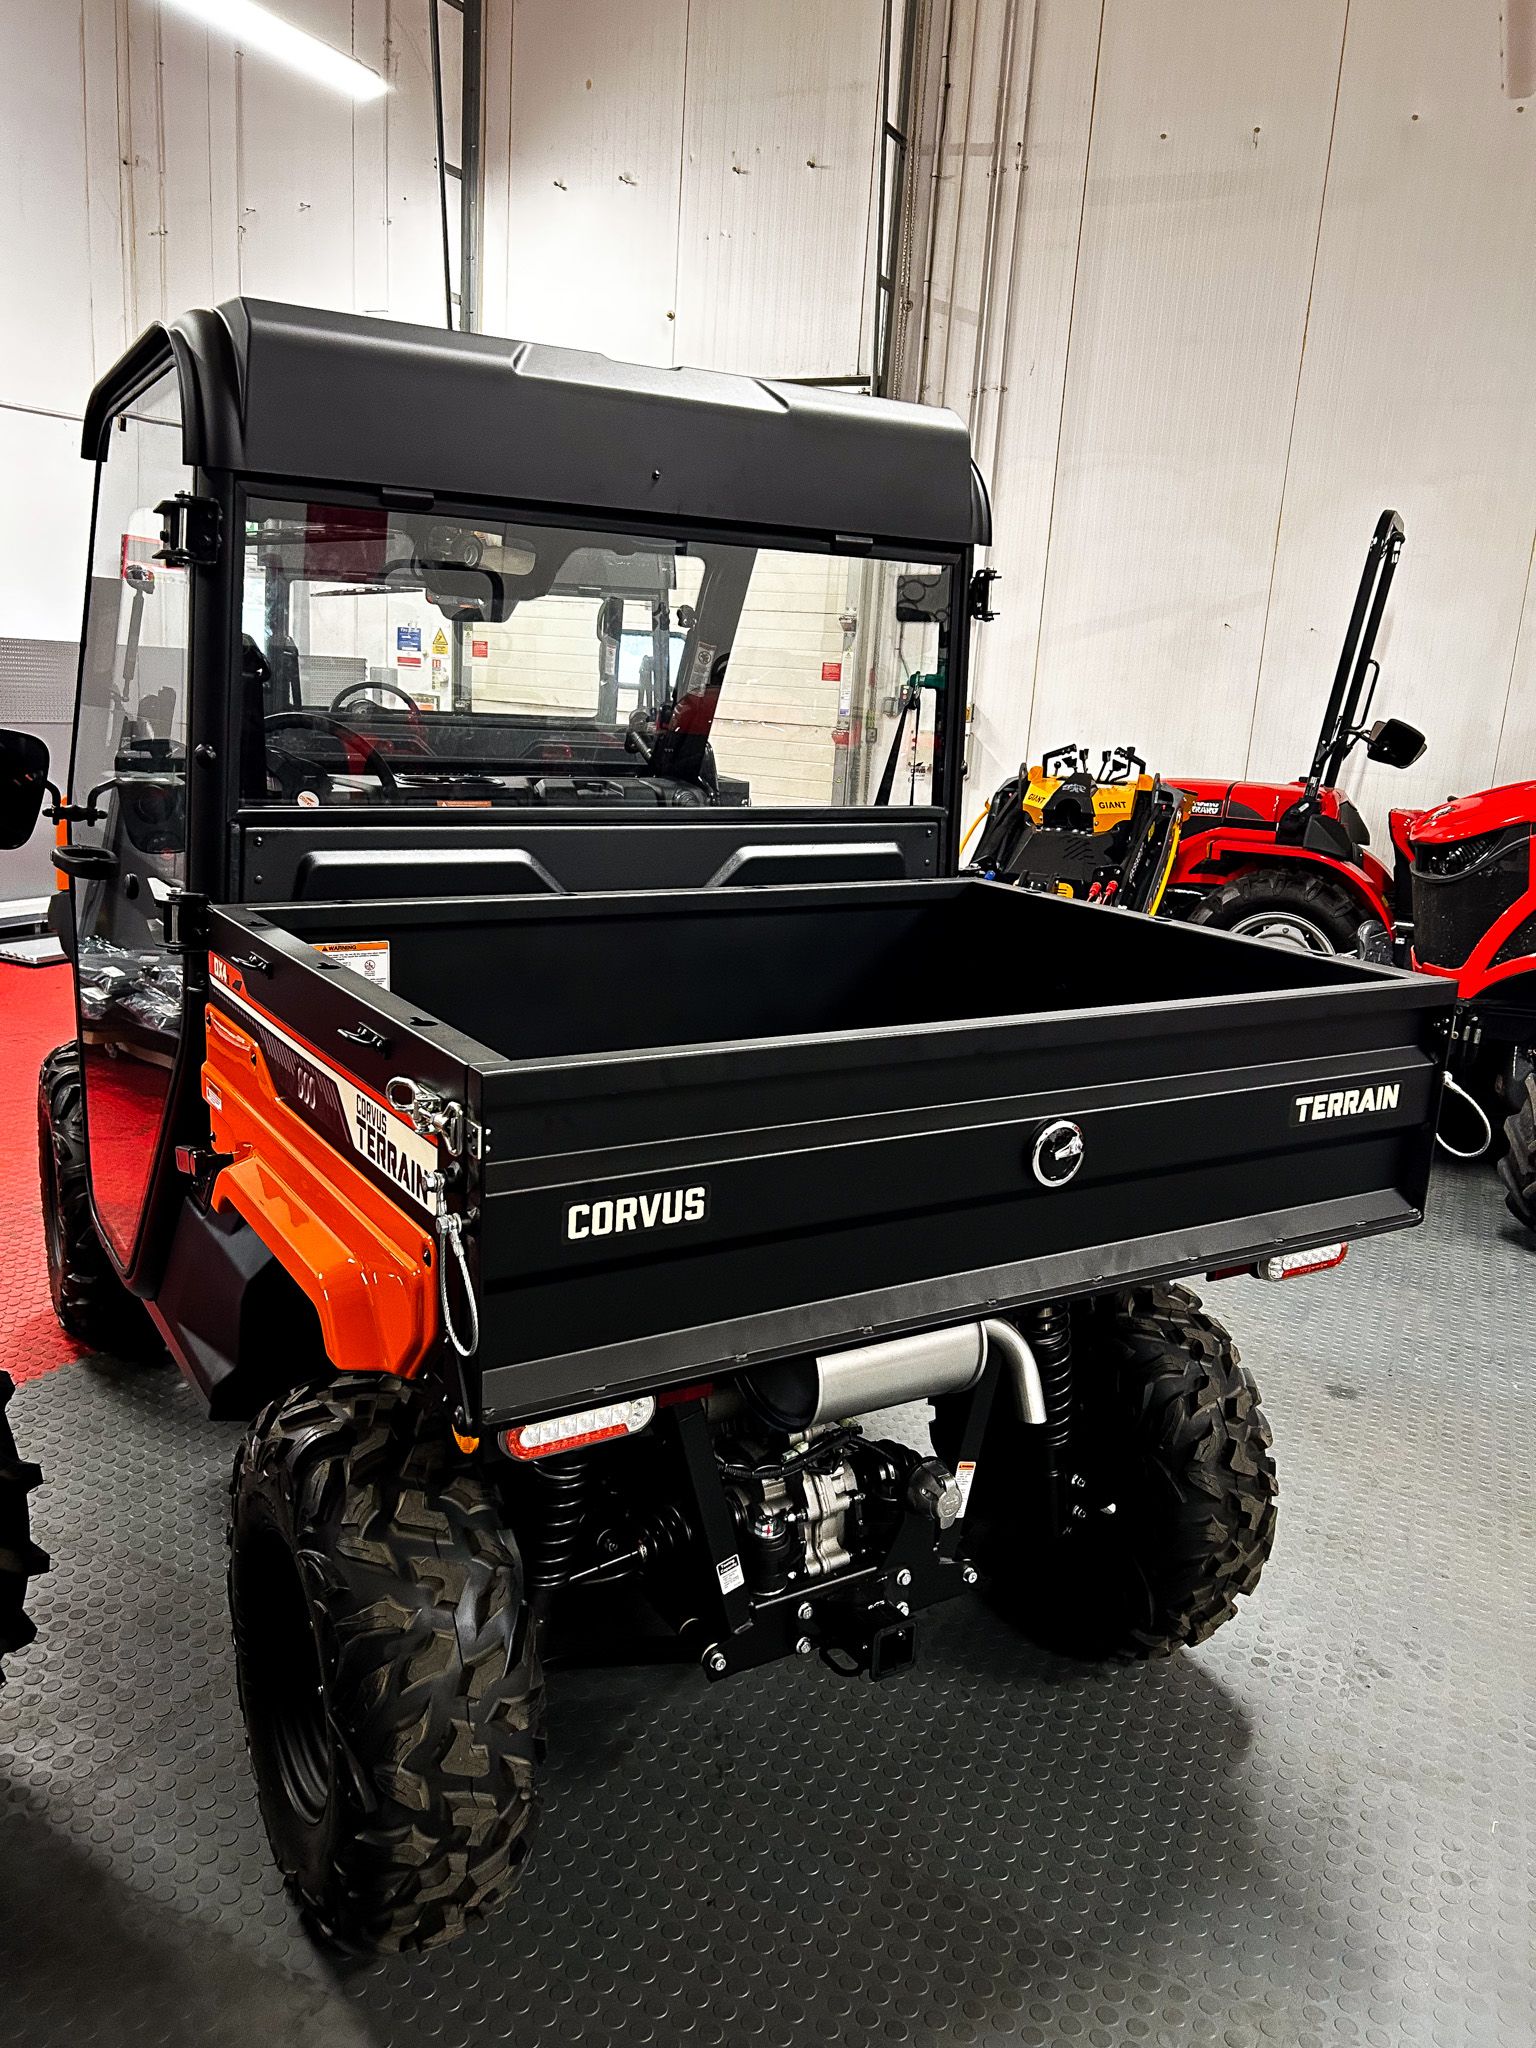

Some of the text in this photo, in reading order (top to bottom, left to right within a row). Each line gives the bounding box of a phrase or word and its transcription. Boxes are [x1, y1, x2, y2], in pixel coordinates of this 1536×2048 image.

[1098, 801, 1127, 809] GIANT
[213, 956, 227, 983] DX4
[356, 1093, 387, 1136] CORVUS
[1295, 1083, 1400, 1123] TERRAIN
[356, 1114, 428, 1206] TERRAIN
[567, 1186, 706, 1240] CORVUS
